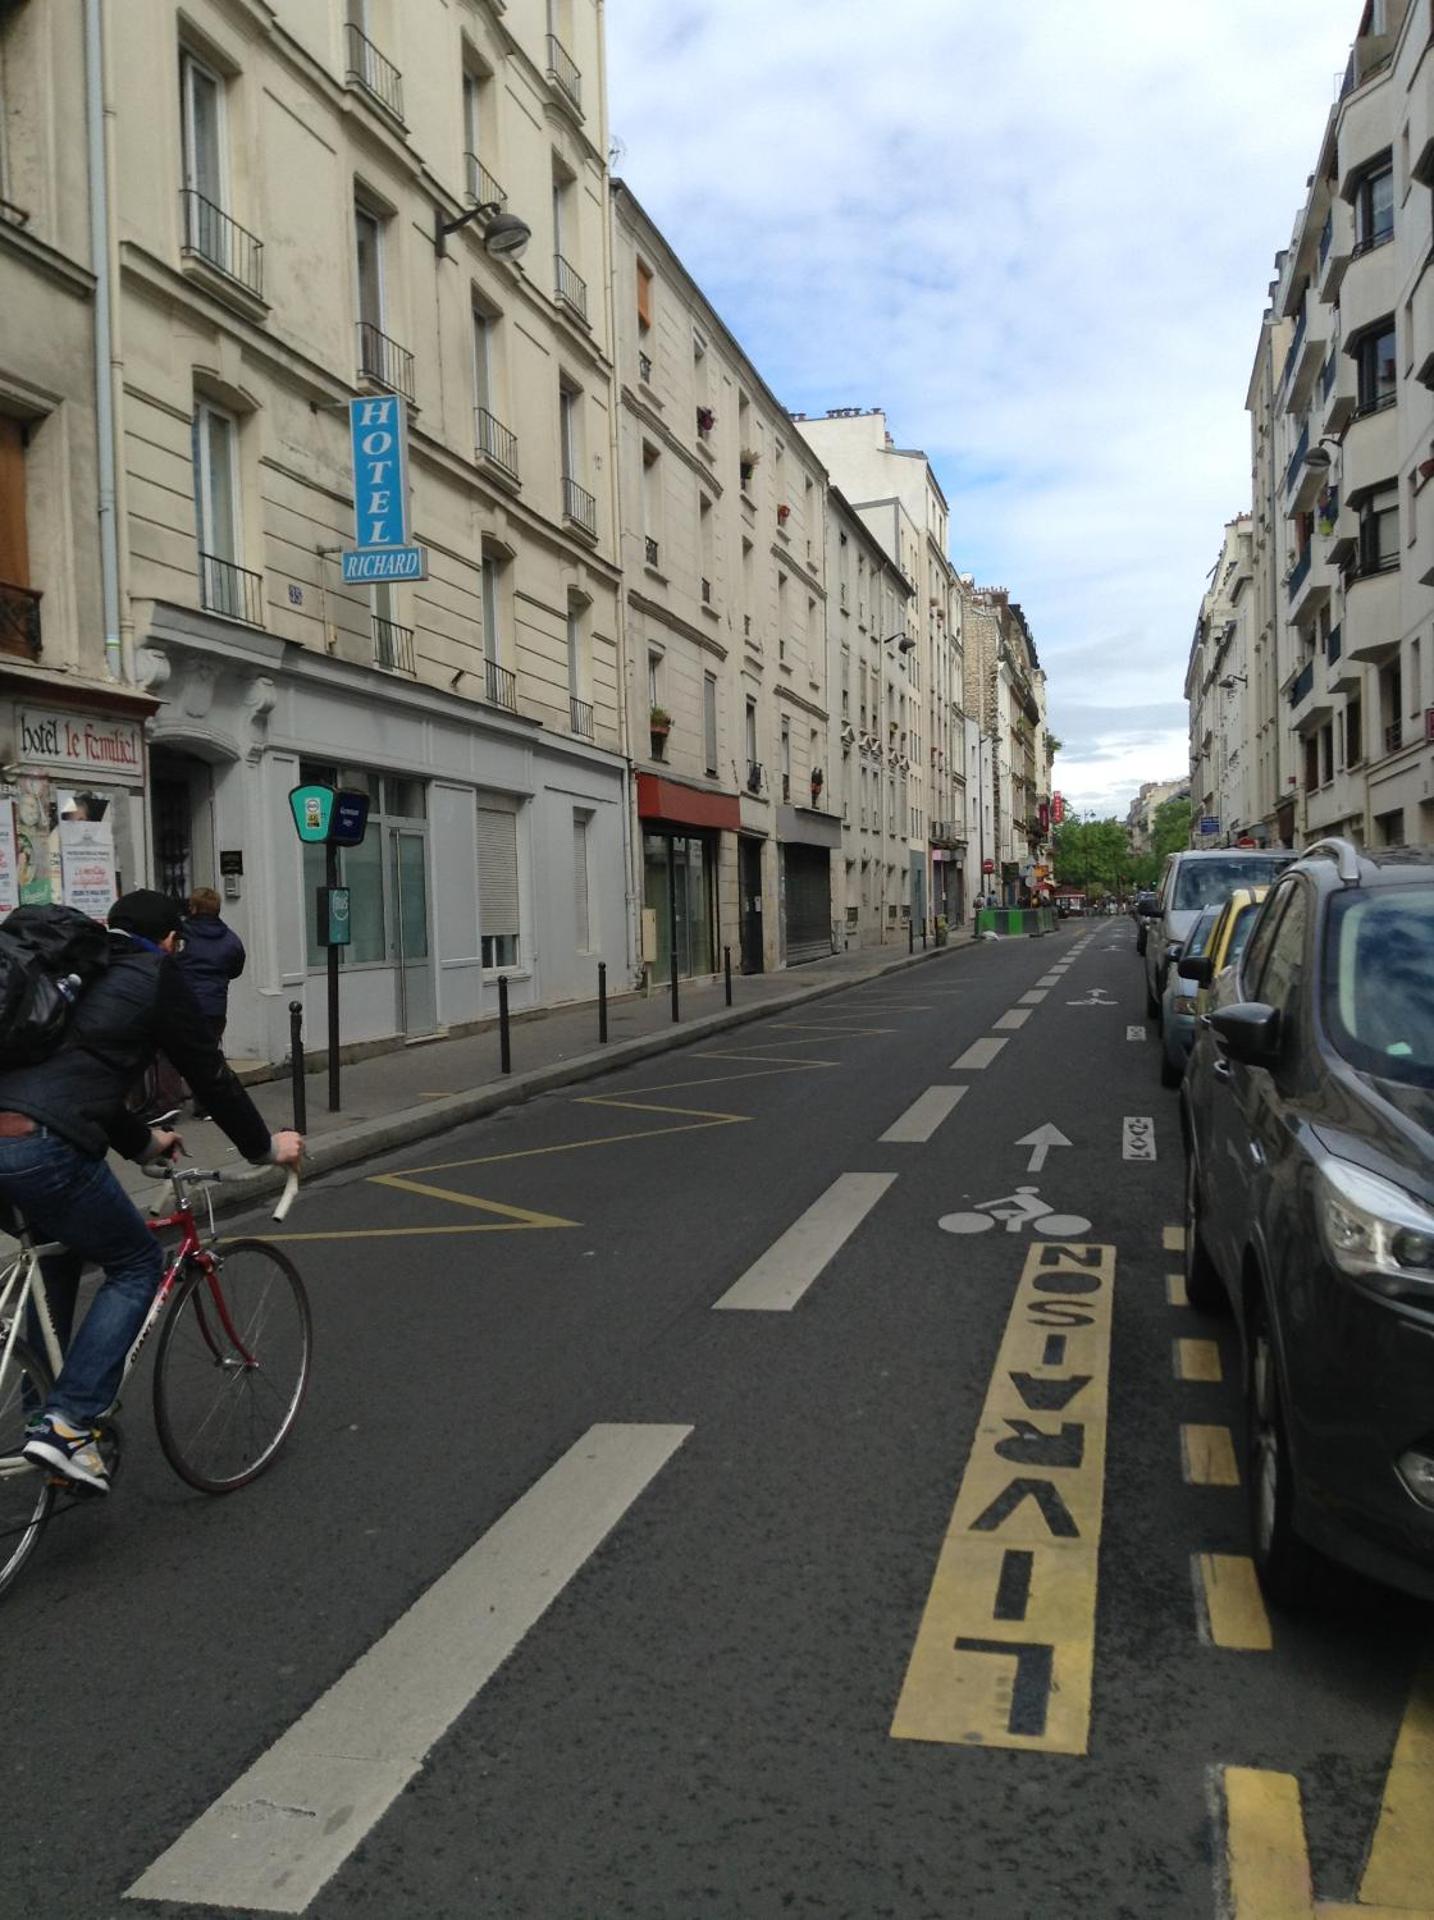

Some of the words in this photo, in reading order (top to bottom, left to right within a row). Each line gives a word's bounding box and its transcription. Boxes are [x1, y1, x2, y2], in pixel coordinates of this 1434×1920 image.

[359, 401, 392, 543] HOTEL
[346, 552, 418, 578] RICHARD
[64, 722, 81, 758] le
[954, 1246, 1102, 1736] LIVRAISON
